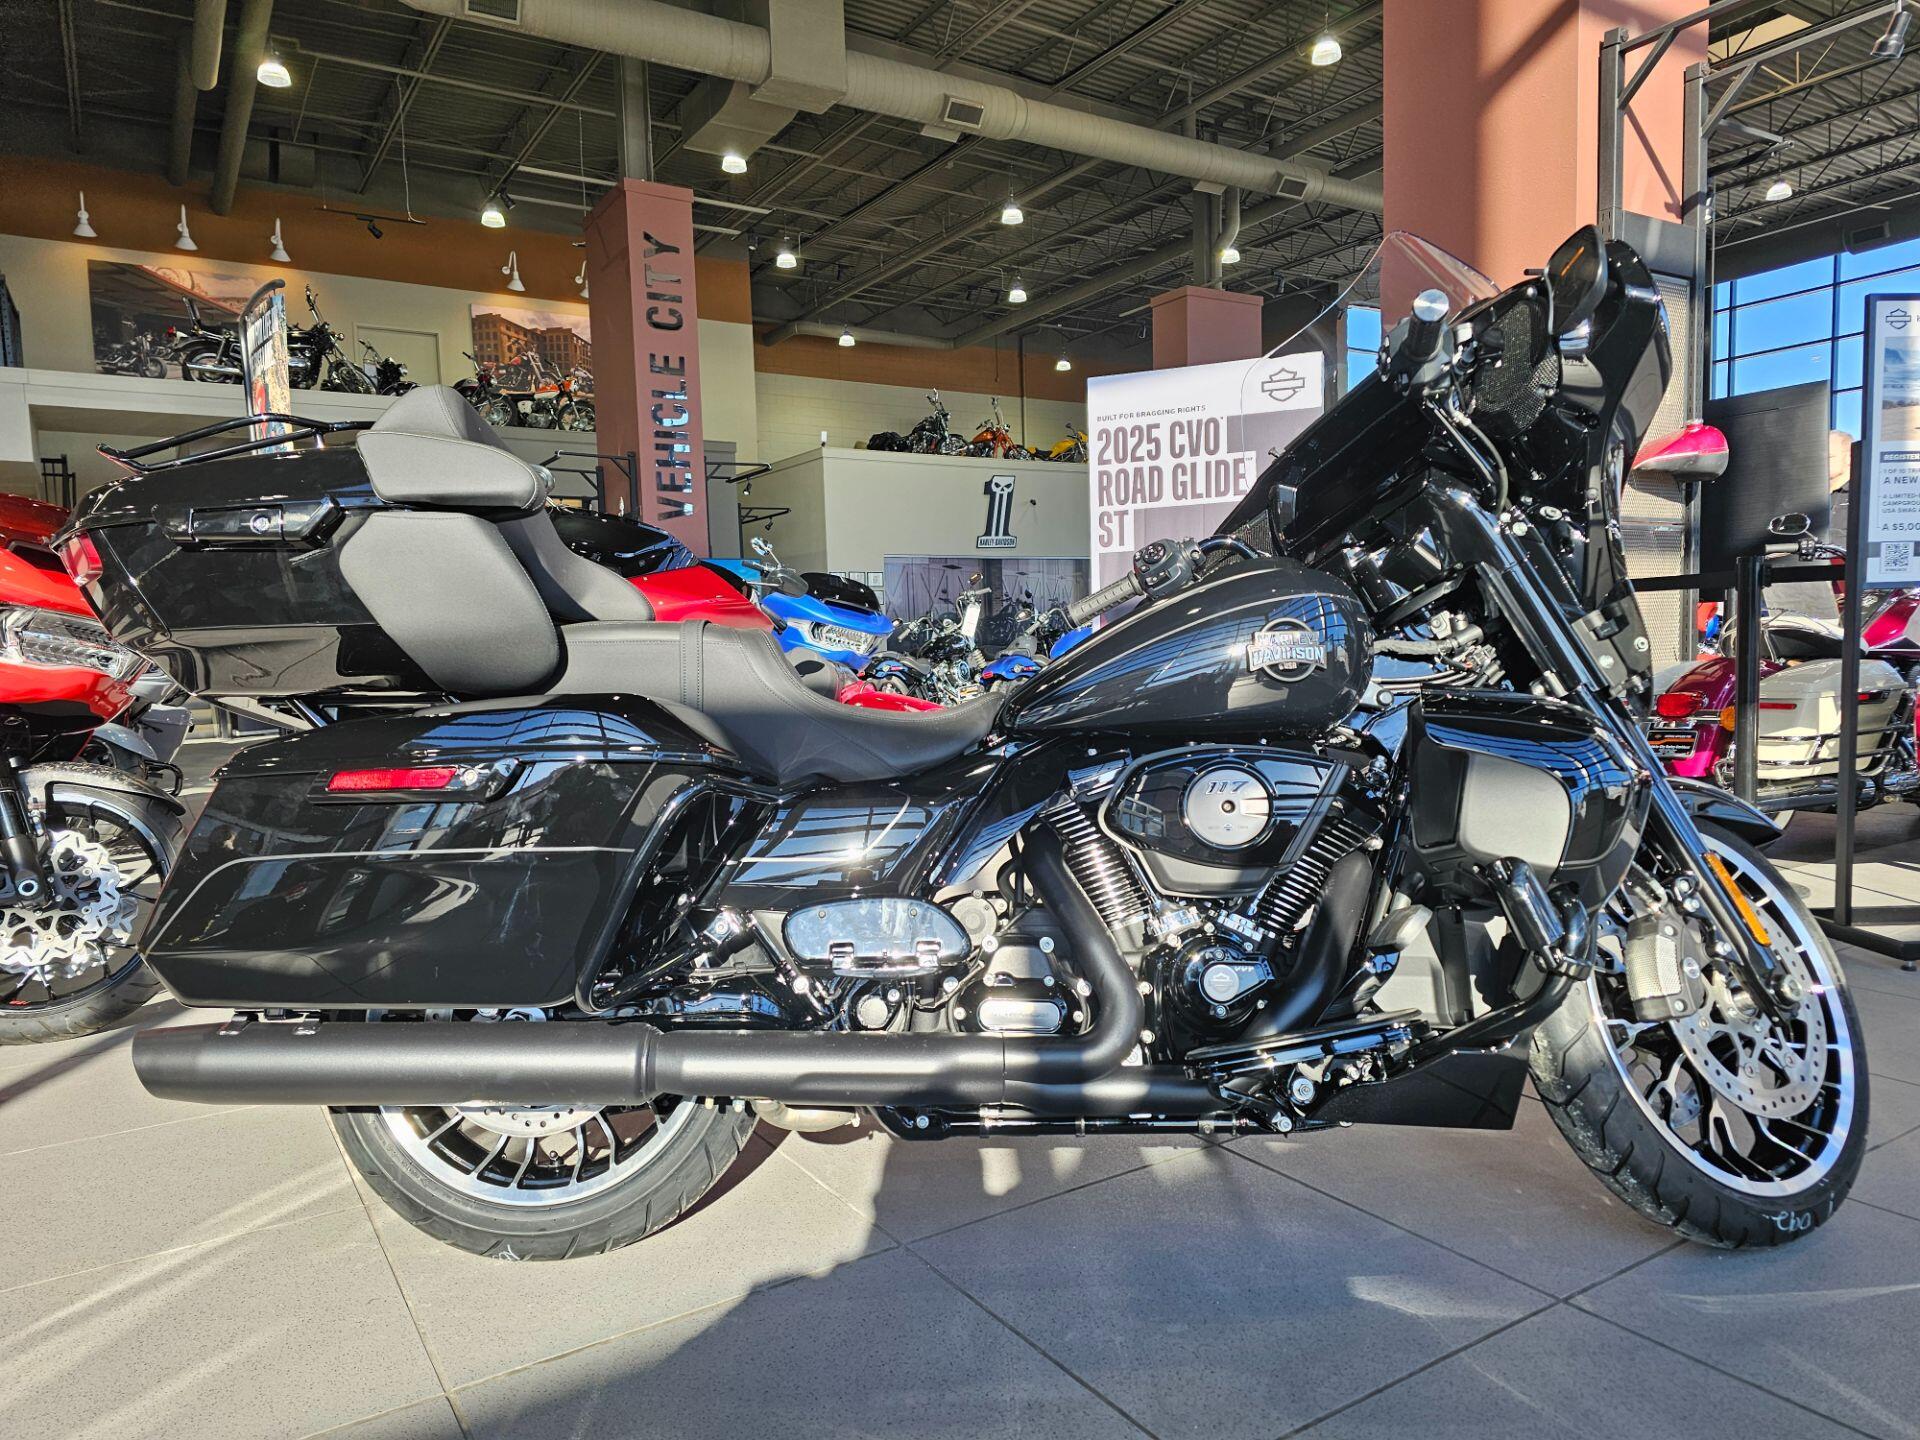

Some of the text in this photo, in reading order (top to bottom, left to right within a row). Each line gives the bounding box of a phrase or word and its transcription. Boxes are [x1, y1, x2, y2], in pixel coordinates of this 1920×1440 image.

[643, 231, 694, 521] VEHICLE CITY
[1097, 414, 1117, 422] BUILT
[1136, 408, 1175, 418] BRAGGING
[1177, 405, 1206, 414] RIGHTS
[1097, 422, 1162, 466] 2025
[1098, 465, 1164, 507] ROAD
[1883, 476, 1918, 484] A NEW
[1098, 510, 1129, 548] ST
[1882, 523, 1889, 531] A
[1252, 646, 1324, 666] DAVIDSON
[1205, 780, 1250, 795] 117
